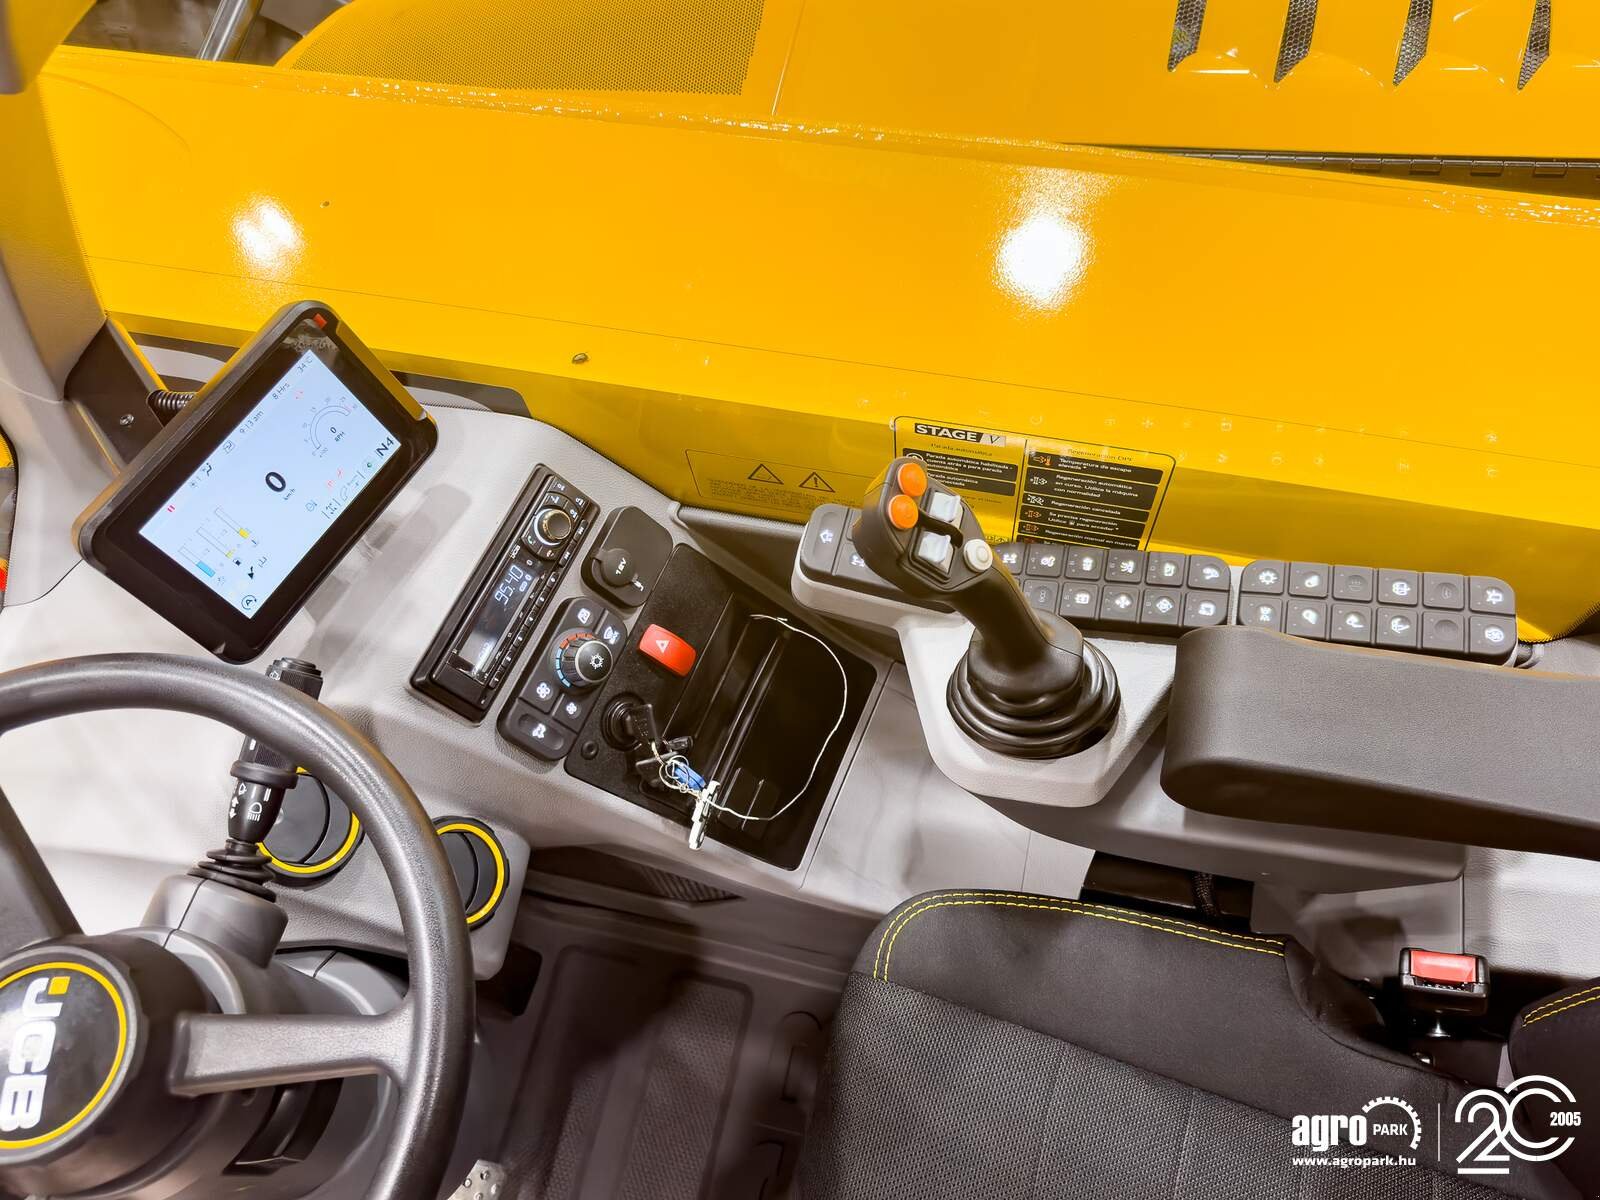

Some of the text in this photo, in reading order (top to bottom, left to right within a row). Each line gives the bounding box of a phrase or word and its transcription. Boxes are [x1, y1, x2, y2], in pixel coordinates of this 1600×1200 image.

[330, 426, 337, 434] 0
[916, 424, 1000, 444] STAGE V
[376, 437, 394, 457] N4
[1060, 458, 1099, 468] Temperatura
[265, 471, 286, 492] 0
[1056, 474, 1133, 490] Regeneración automática
[1066, 489, 1101, 498] normalidad
[1051, 500, 1091, 510] Regeneración
[494, 564, 523, 606] 95.40
[0, 976, 70, 1132] JCB
